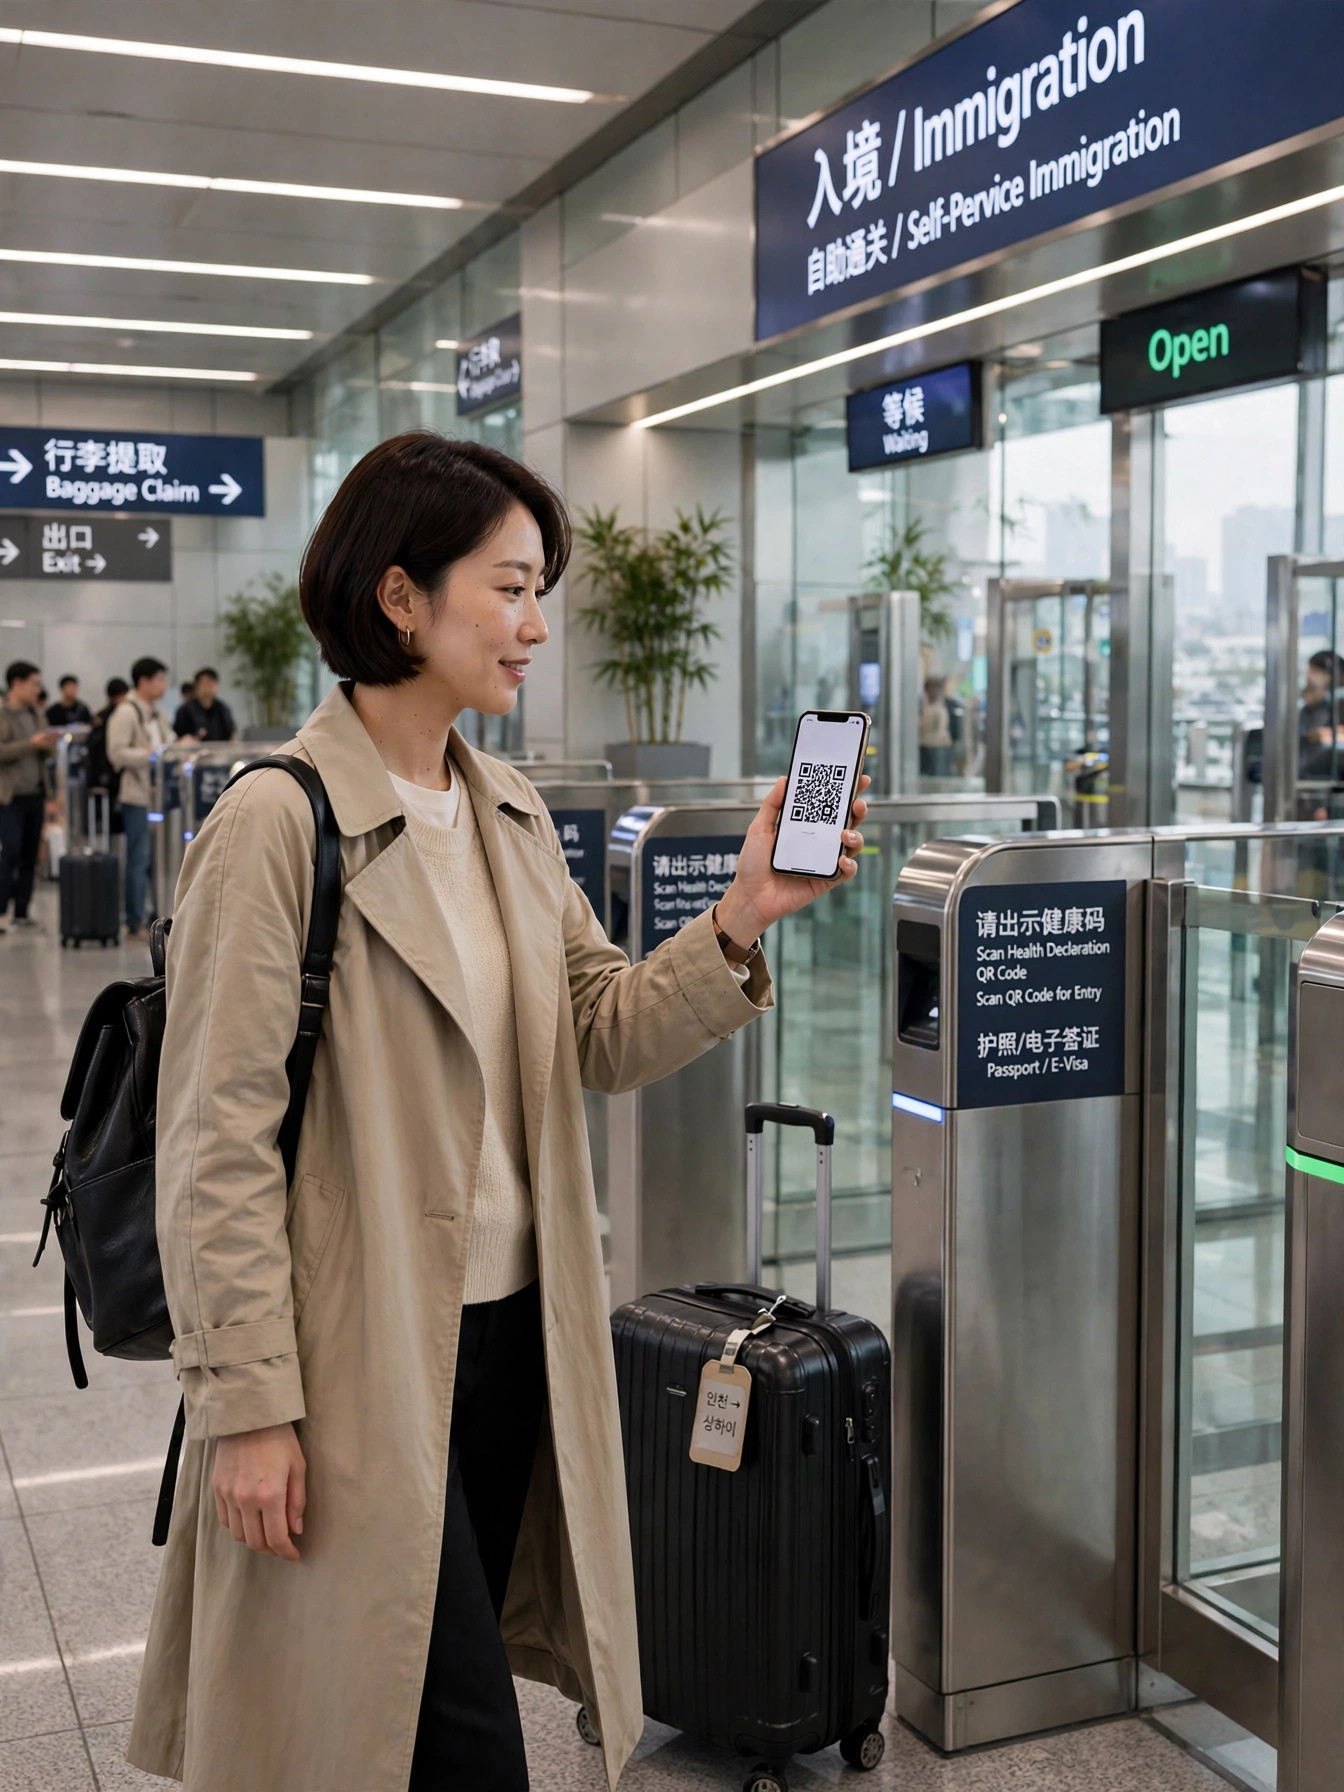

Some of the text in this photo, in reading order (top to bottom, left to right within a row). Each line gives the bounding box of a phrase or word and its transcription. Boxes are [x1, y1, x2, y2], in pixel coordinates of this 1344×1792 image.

[807, 119, 882, 230] 入境
[914, 9, 1145, 173] Immigration
[807, 218, 888, 296] 自助通关
[907, 173, 1024, 250] Self-Pervice
[1029, 107, 1181, 200] Immigration
[1148, 323, 1229, 379] Open
[882, 386, 925, 430] 等候
[46, 475, 200, 506] Baggage Claim
[42, 522, 92, 550] 出口
[42, 551, 81, 573] Exit
[653, 881, 677, 895] Scan
[653, 917, 677, 930] Scan
[976, 906, 1105, 939] 请出示健康码
[976, 939, 1110, 961] Scan Health Declaration
[976, 964, 1027, 983] QR Code
[976, 985, 1102, 1006] Scan QR Code for Entry
[987, 1060, 1040, 1080] Passport
[1051, 1055, 1089, 1072] E-Visa
